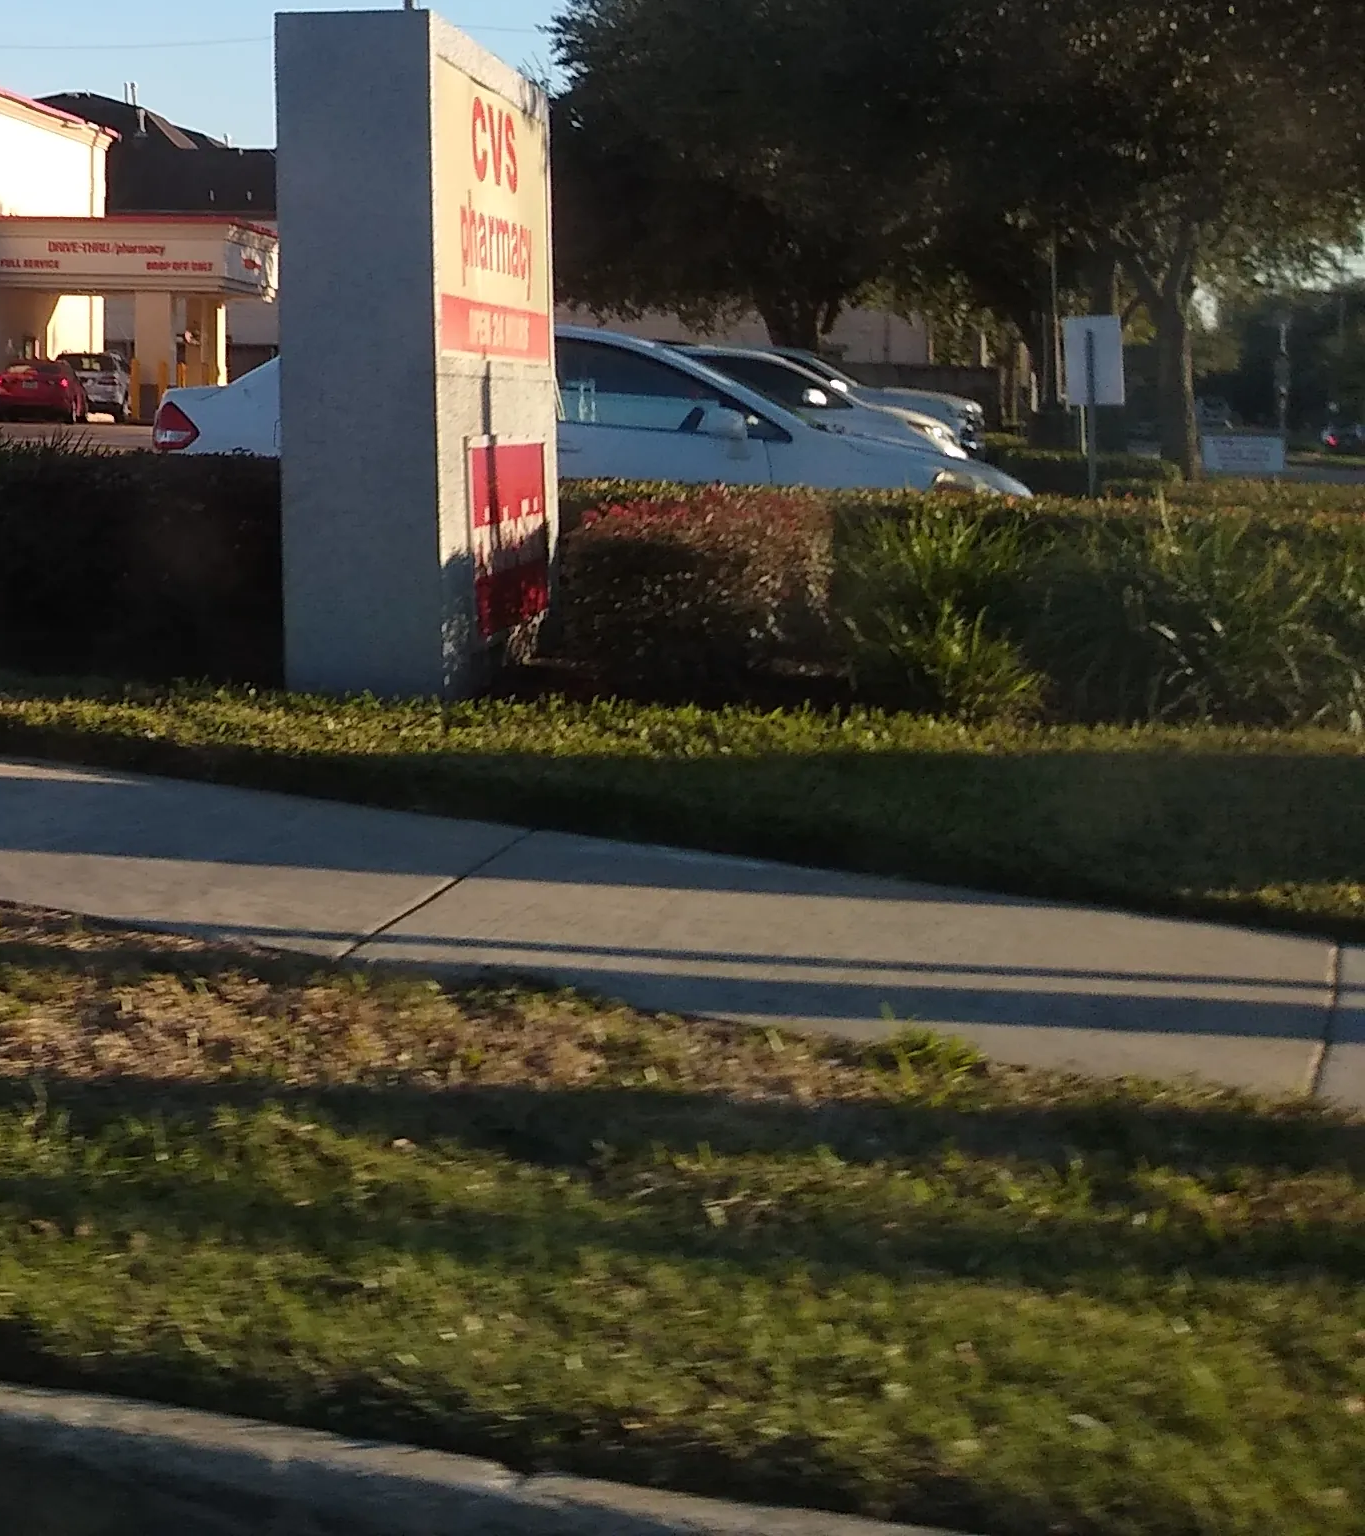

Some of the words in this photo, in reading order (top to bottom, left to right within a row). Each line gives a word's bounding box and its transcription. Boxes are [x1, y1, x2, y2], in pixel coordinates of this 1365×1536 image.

[472, 96, 518, 194] CVS
[23, 259, 60, 268] SERVICE
[460, 189, 532, 302] pharmacy
